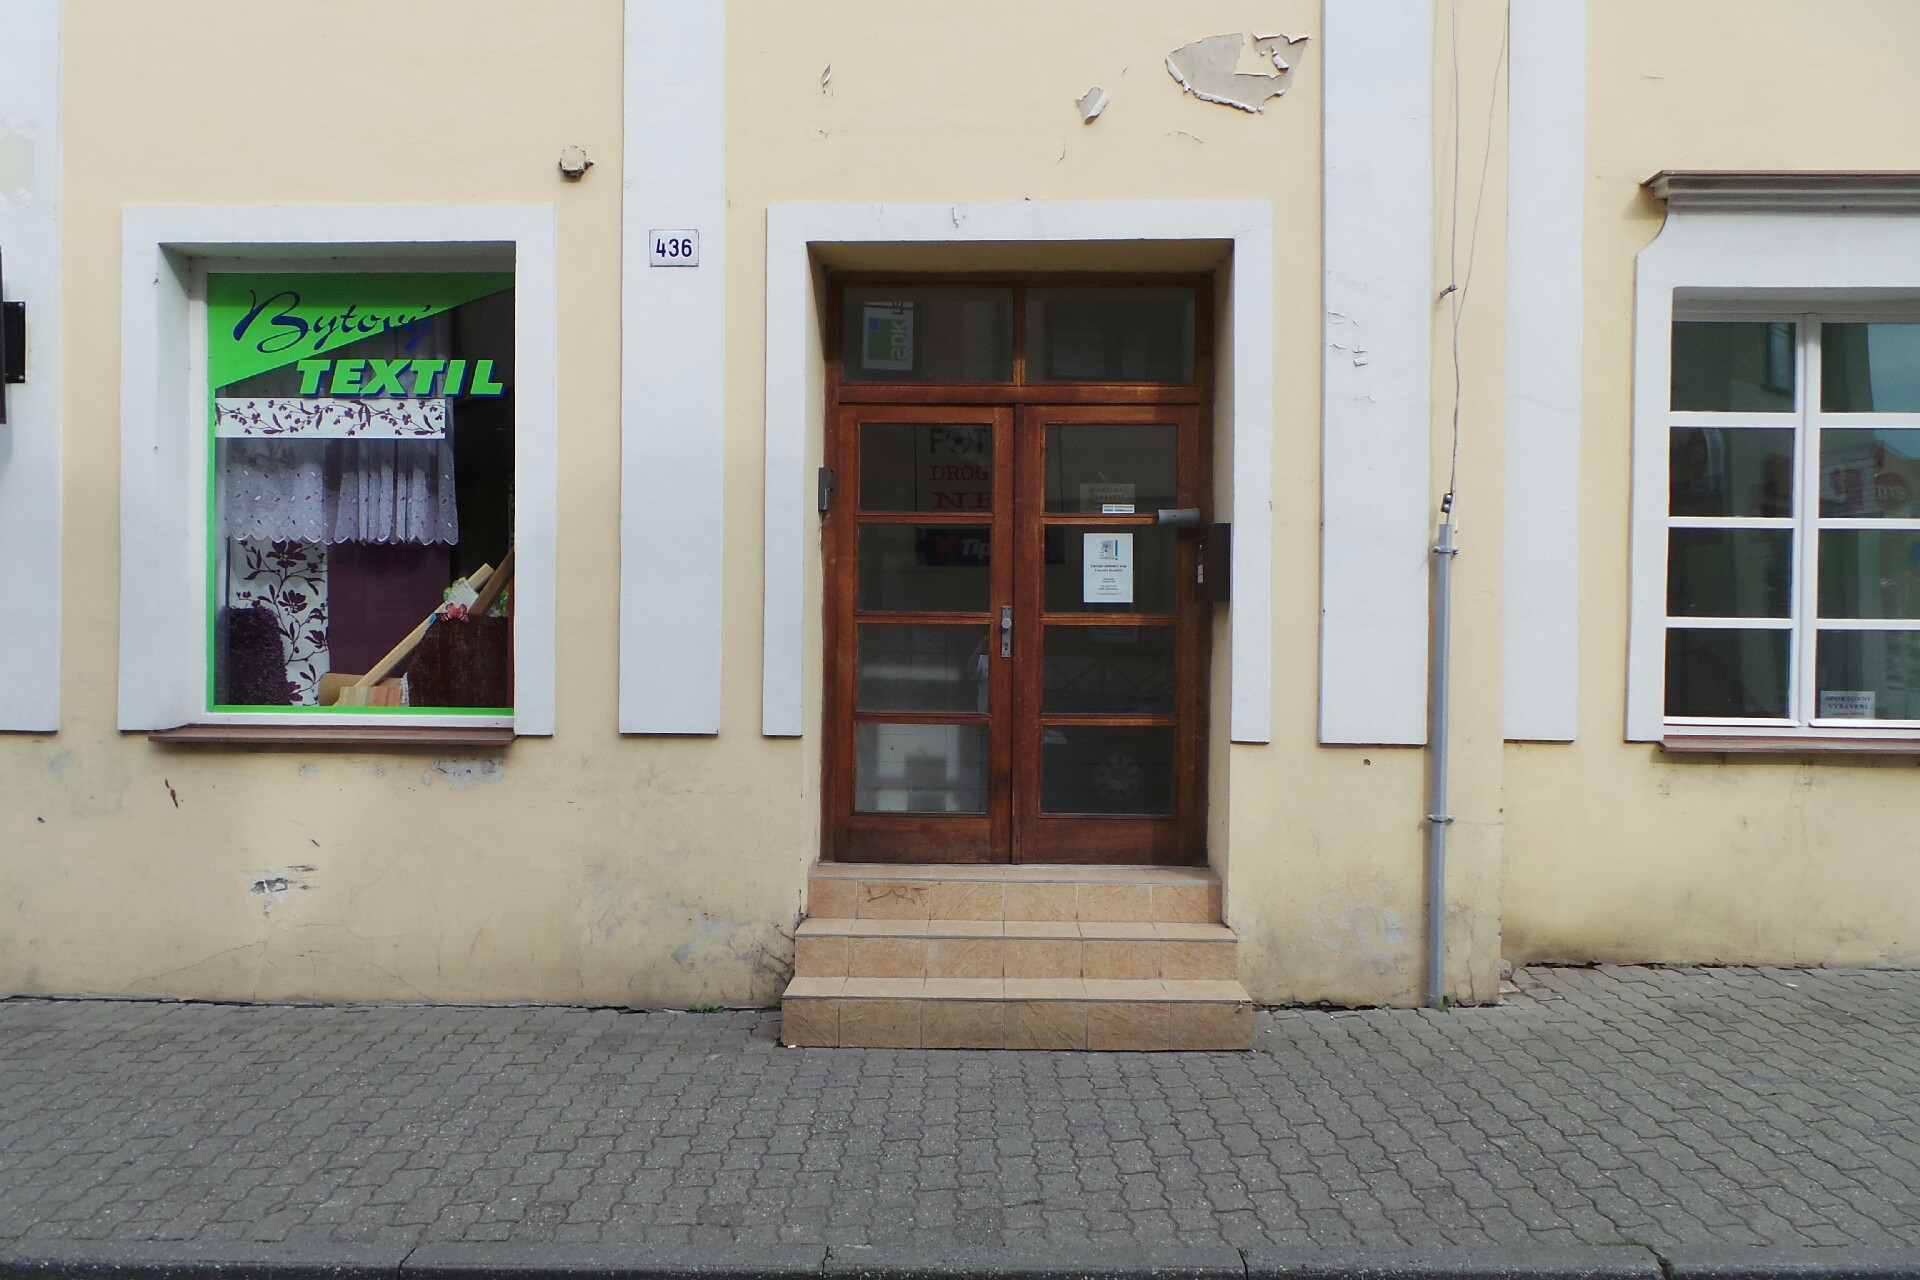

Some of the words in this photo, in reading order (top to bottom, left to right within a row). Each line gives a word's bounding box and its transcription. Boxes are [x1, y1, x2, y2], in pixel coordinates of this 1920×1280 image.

[656, 238, 692, 257] 436
[233, 290, 431, 353] Bytový
[297, 359, 506, 397] TEXTIL
[930, 464, 990, 481] DROG
